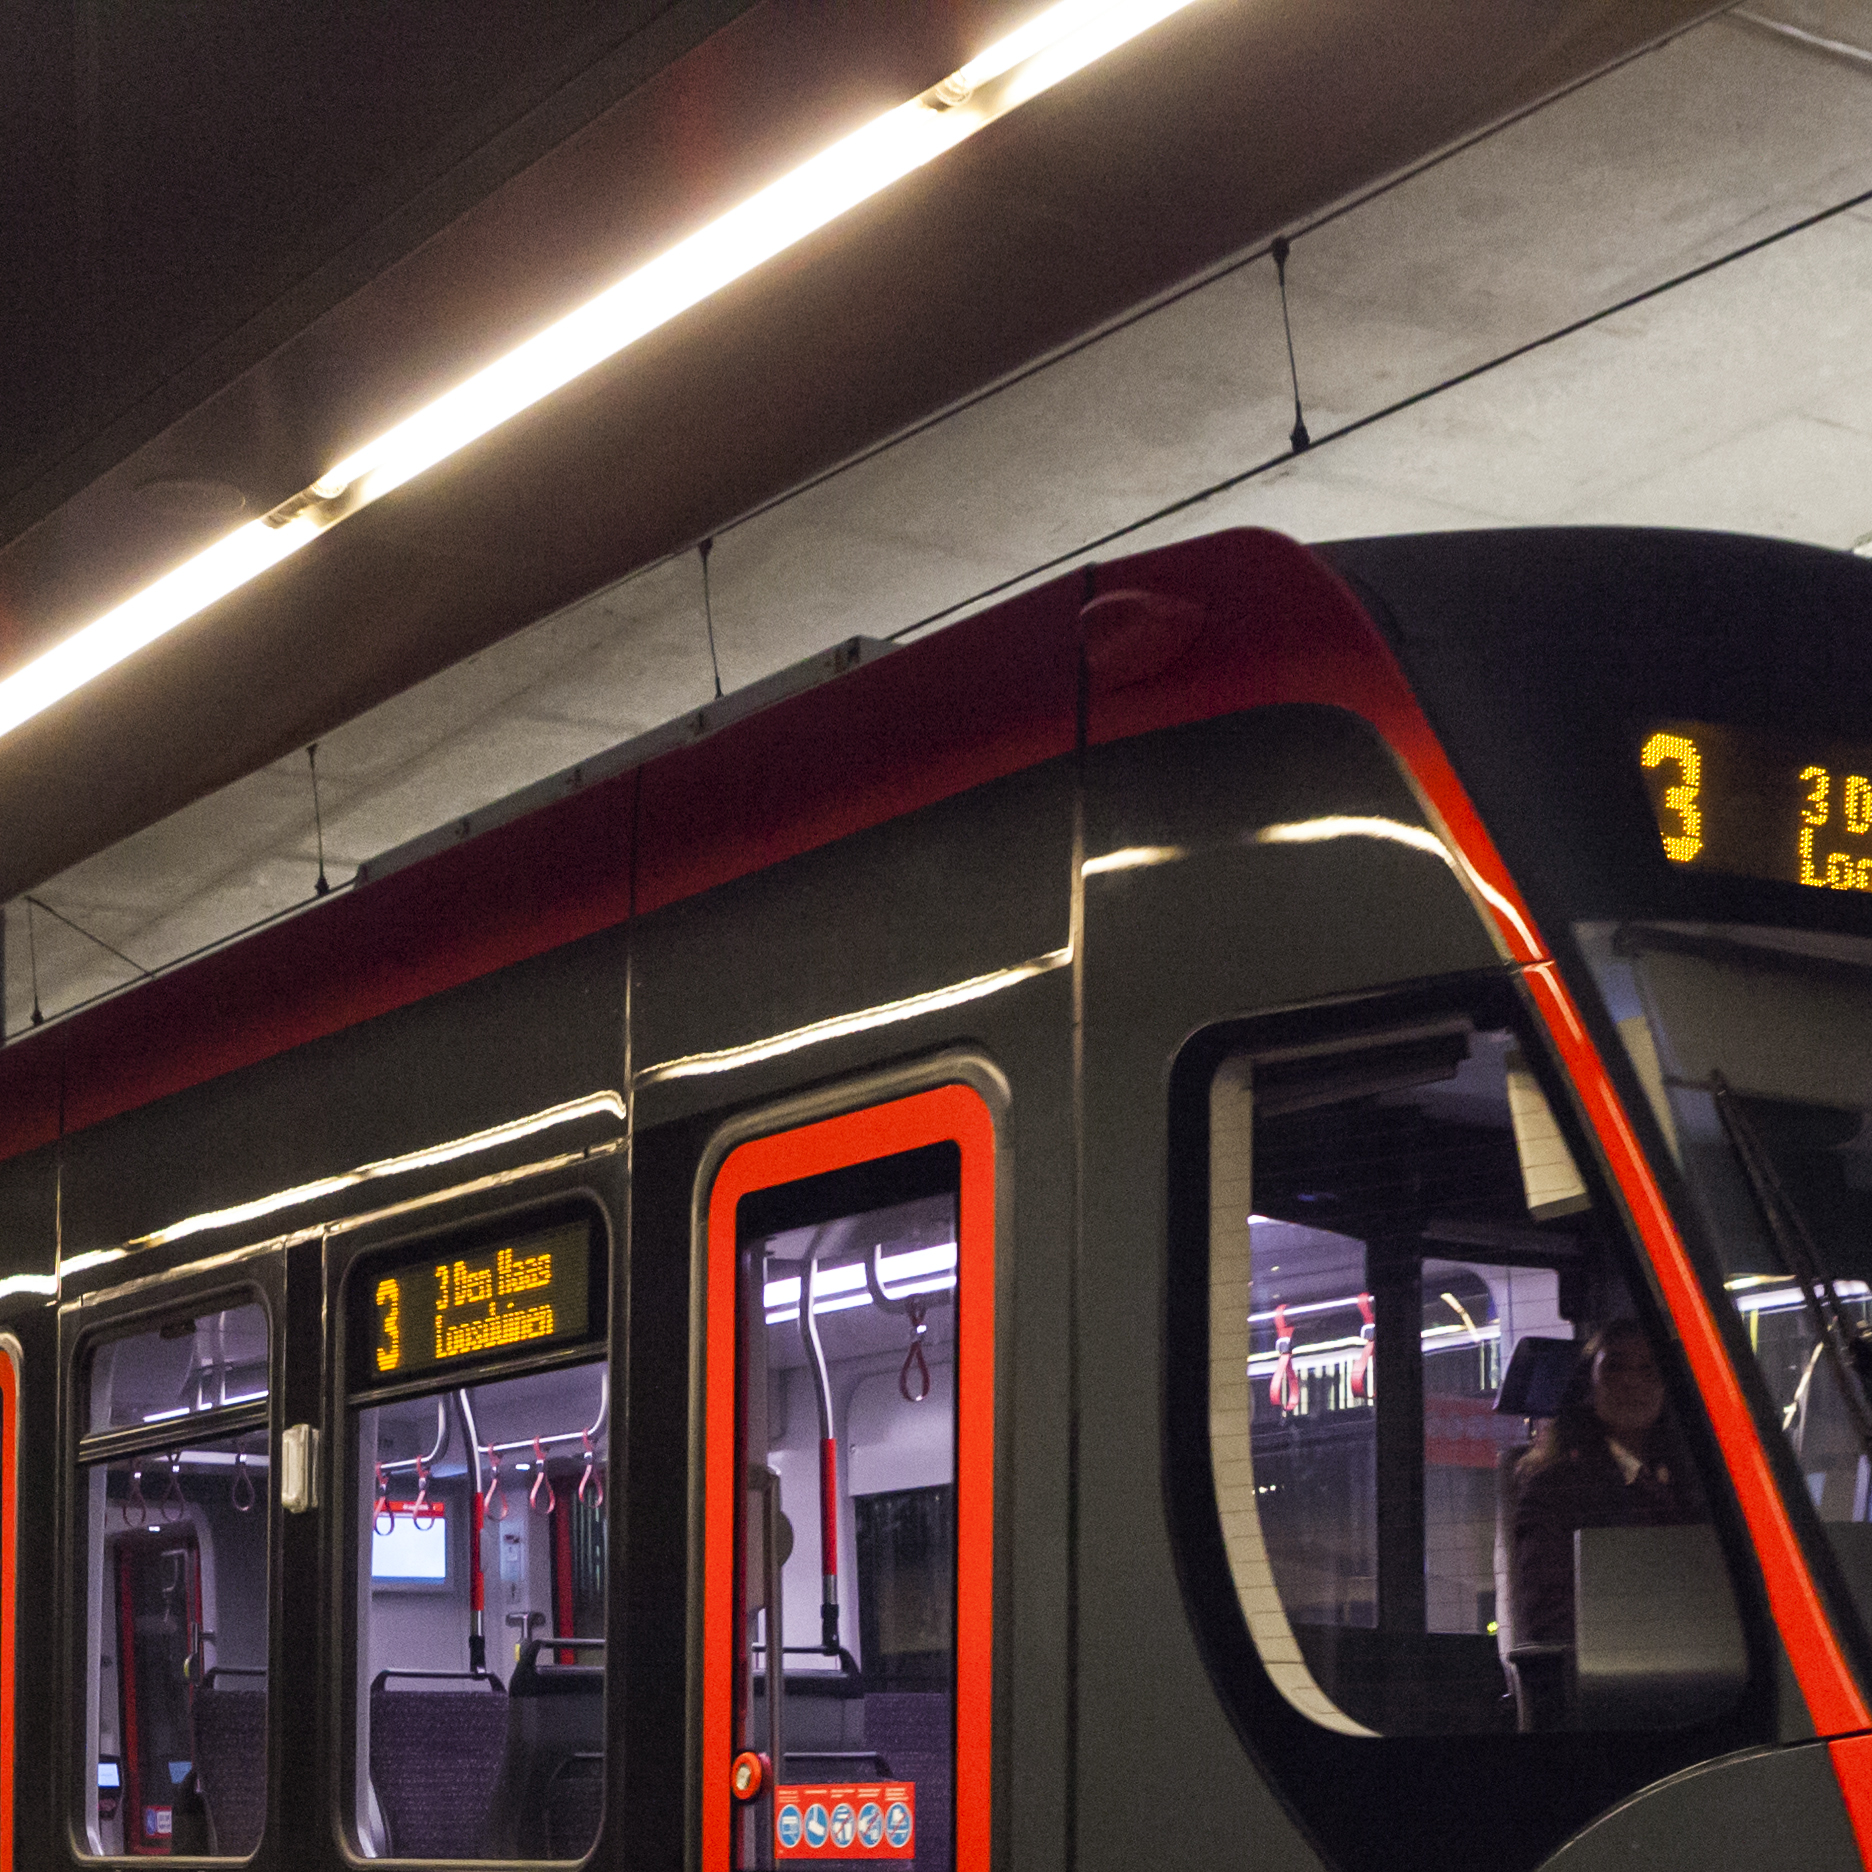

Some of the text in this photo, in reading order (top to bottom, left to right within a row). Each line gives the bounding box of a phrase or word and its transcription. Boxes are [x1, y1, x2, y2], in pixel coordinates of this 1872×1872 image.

[1641, 733, 1703, 862] 3
[1799, 766, 1830, 826] 3
[435, 1248, 552, 1311] 3 Den Haag
[376, 1278, 401, 1372] 3
[435, 1301, 555, 1359] Loosduinen
